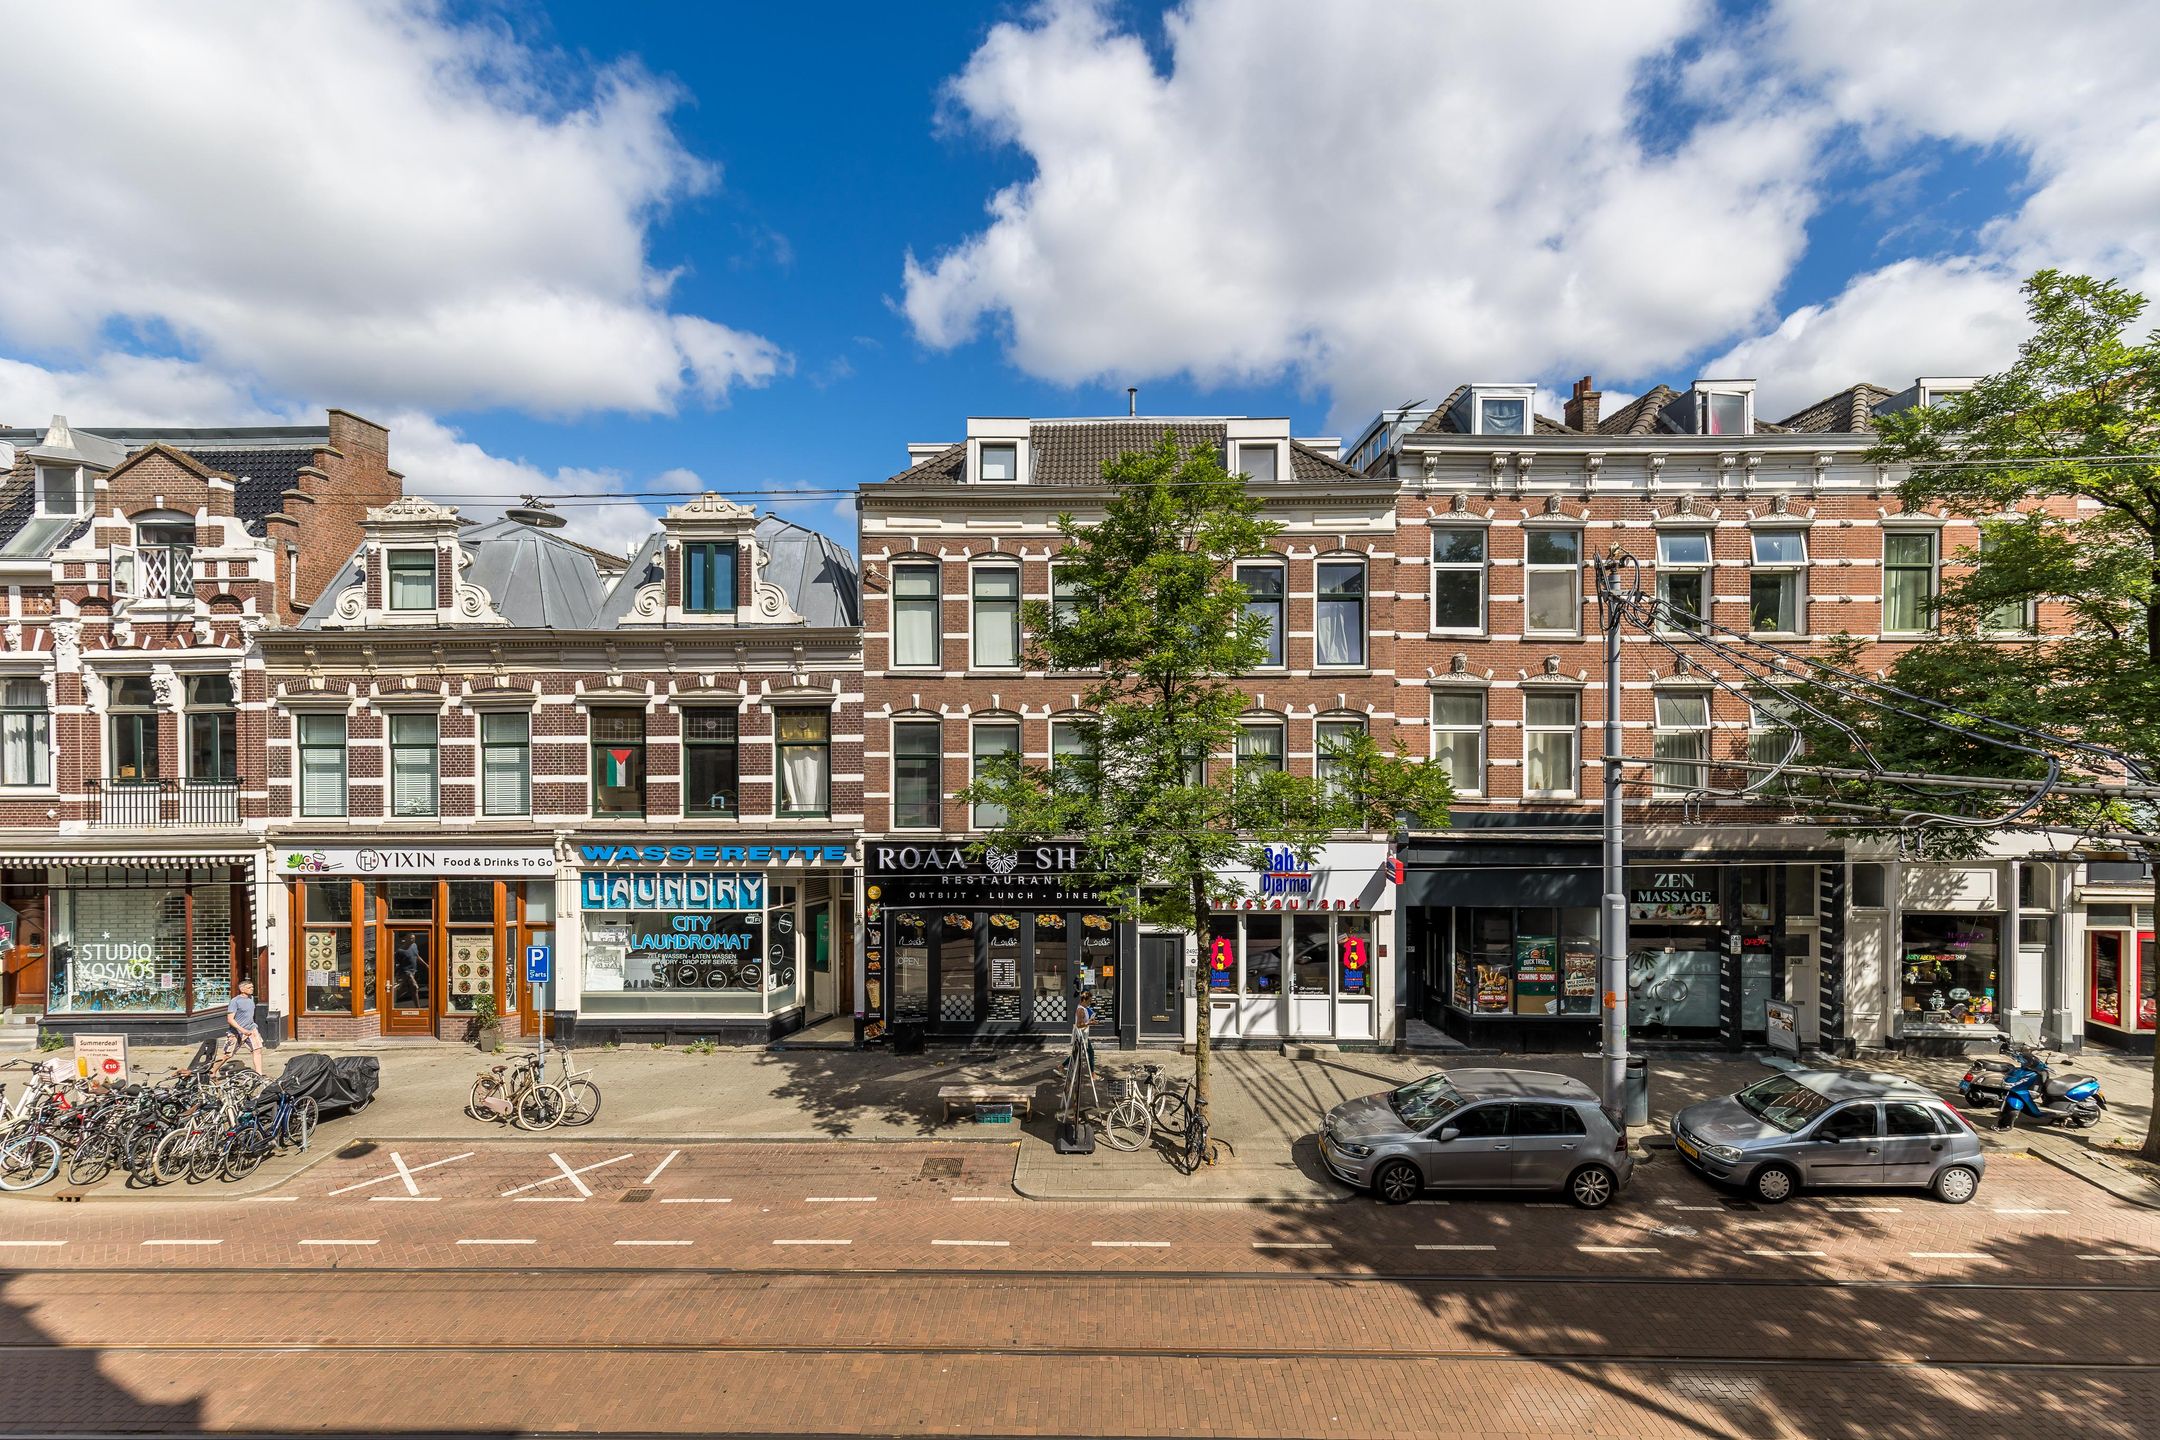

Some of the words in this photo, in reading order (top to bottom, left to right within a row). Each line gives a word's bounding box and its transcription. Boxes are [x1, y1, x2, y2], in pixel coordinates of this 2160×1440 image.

[380, 852, 435, 868] YIXIN
[443, 858, 471, 867] Food
[473, 858, 482, 867] &
[484, 858, 519, 867] Drinks
[522, 858, 535, 867] To
[537, 858, 553, 867] Go
[580, 845, 847, 862] WASSERETTE
[877, 847, 968, 870] ROAA
[588, 876, 763, 902] LAUNDRY
[1263, 873, 1312, 896] Djarmai
[1654, 873, 1695, 888] ZEN
[909, 892, 967, 900] ONTBIJT
[989, 892, 1034, 900] LUNCH
[1056, 892, 1098, 900] DINER
[1638, 890, 1712, 903] MASSAGE
[672, 915, 713, 932] CITY
[631, 933, 753, 950] LAUNDROMAT
[531, 948, 545, 967] P
[80, 962, 156, 980] KOSMOS
